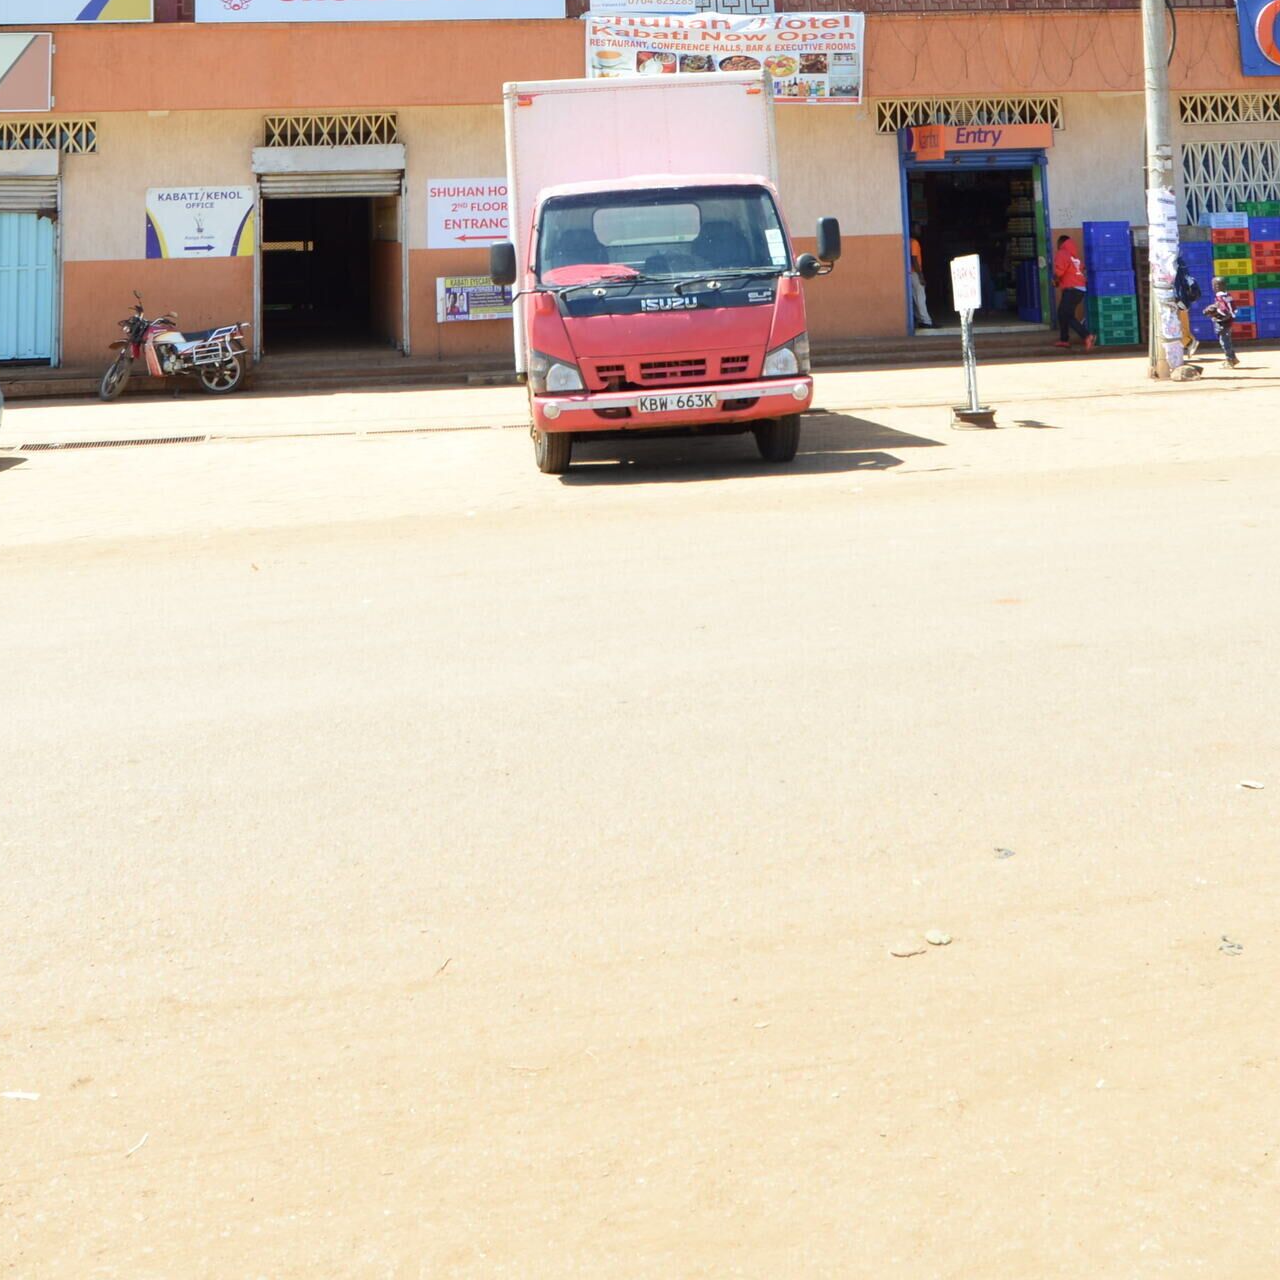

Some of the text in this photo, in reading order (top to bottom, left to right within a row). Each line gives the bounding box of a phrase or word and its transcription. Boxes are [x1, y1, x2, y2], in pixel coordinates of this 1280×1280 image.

[591, 25, 855, 43] Kabati Now Open
[590, 38, 857, 53] RESTAURANT, CONFERENCE HALLS, BAR & EXECUTIVE ROOMS
[955, 127, 1003, 147] Entry
[157, 191, 243, 201] KABATI/KENOL
[429, 186, 508, 198] SHUHAN HO
[451, 202, 508, 213] 2ND FLOOR
[444, 217, 508, 230] ENTRANC
[641, 296, 698, 312] ISUZU
[640, 394, 713, 412] KBW 663K
